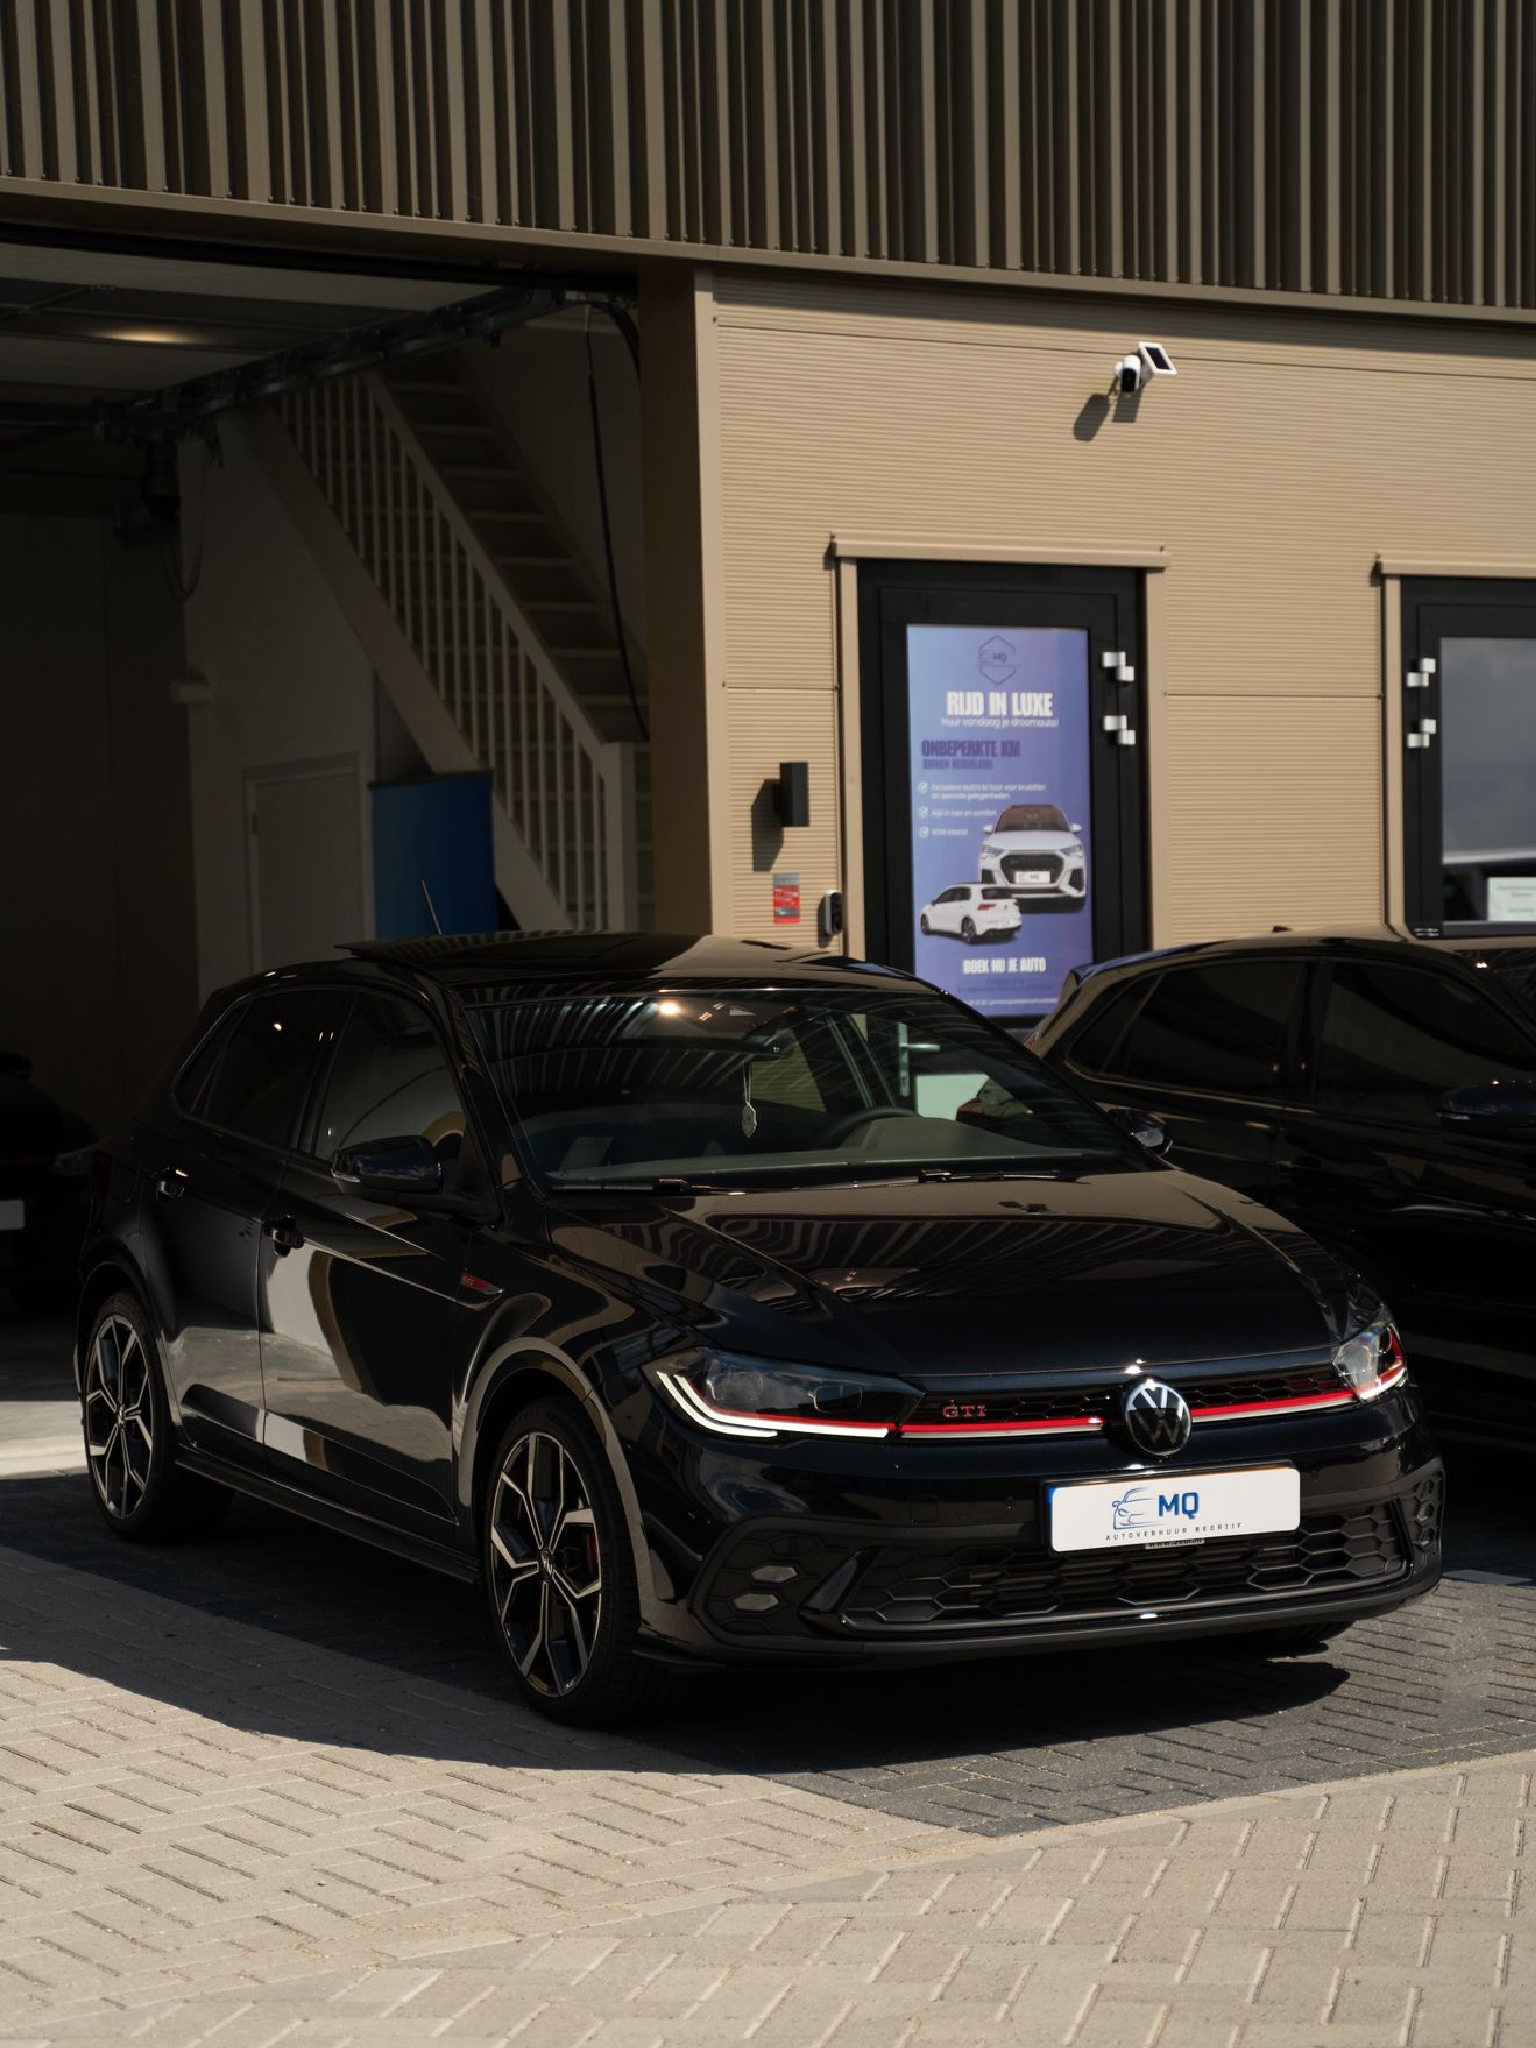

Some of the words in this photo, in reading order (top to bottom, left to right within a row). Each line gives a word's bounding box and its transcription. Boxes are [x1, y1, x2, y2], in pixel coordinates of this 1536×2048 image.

[946, 691, 984, 716] RIJD
[989, 691, 1007, 716] IN
[1012, 692, 1053, 717] LUXE
[940, 718, 961, 727] Huur
[963, 718, 1000, 729] vandaag
[1001, 718, 1010, 729] je
[921, 740, 998, 757] ONBEPERKTE
[1001, 740, 1021, 757] KM
[963, 959, 989, 975] BOEK
[991, 958, 1005, 973] NU
[1009, 957, 1018, 973] JE
[1020, 957, 1046, 972] AUTO
[941, 1405, 987, 1418] GTI
[1158, 1491, 1199, 1519] MQ
